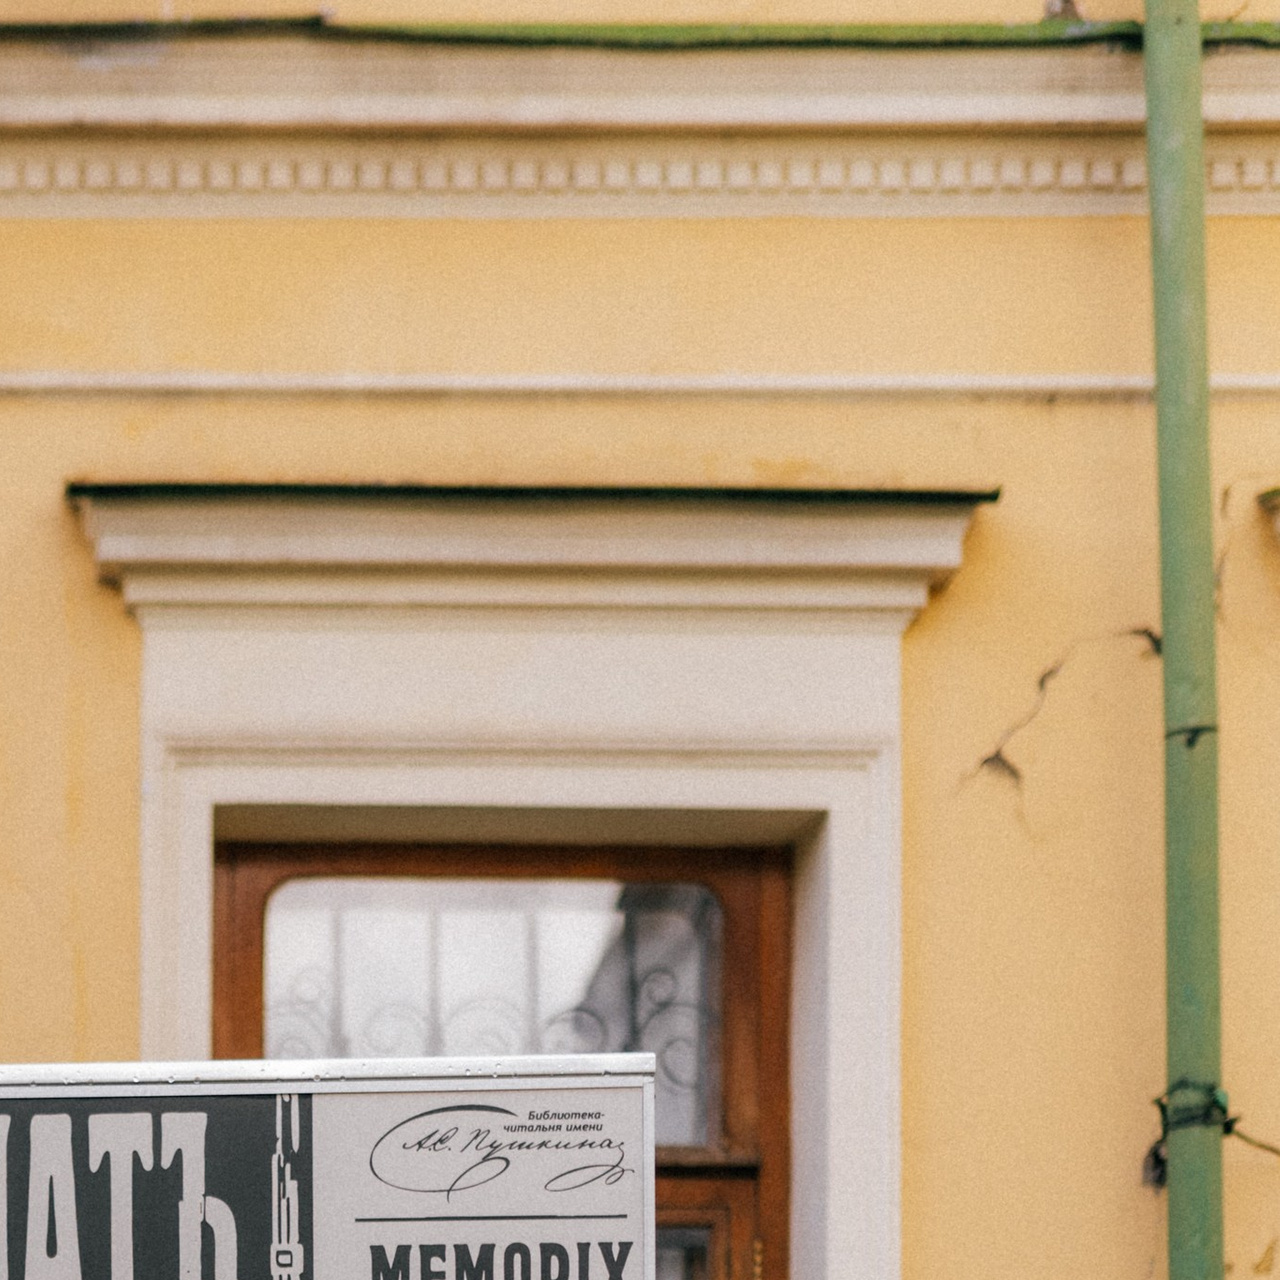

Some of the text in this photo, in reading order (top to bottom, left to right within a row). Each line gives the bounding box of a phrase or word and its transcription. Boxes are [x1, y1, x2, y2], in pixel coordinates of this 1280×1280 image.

[528, 1110, 606, 1121] Библиотека-
[503, 1123, 604, 1133] читальня имени
